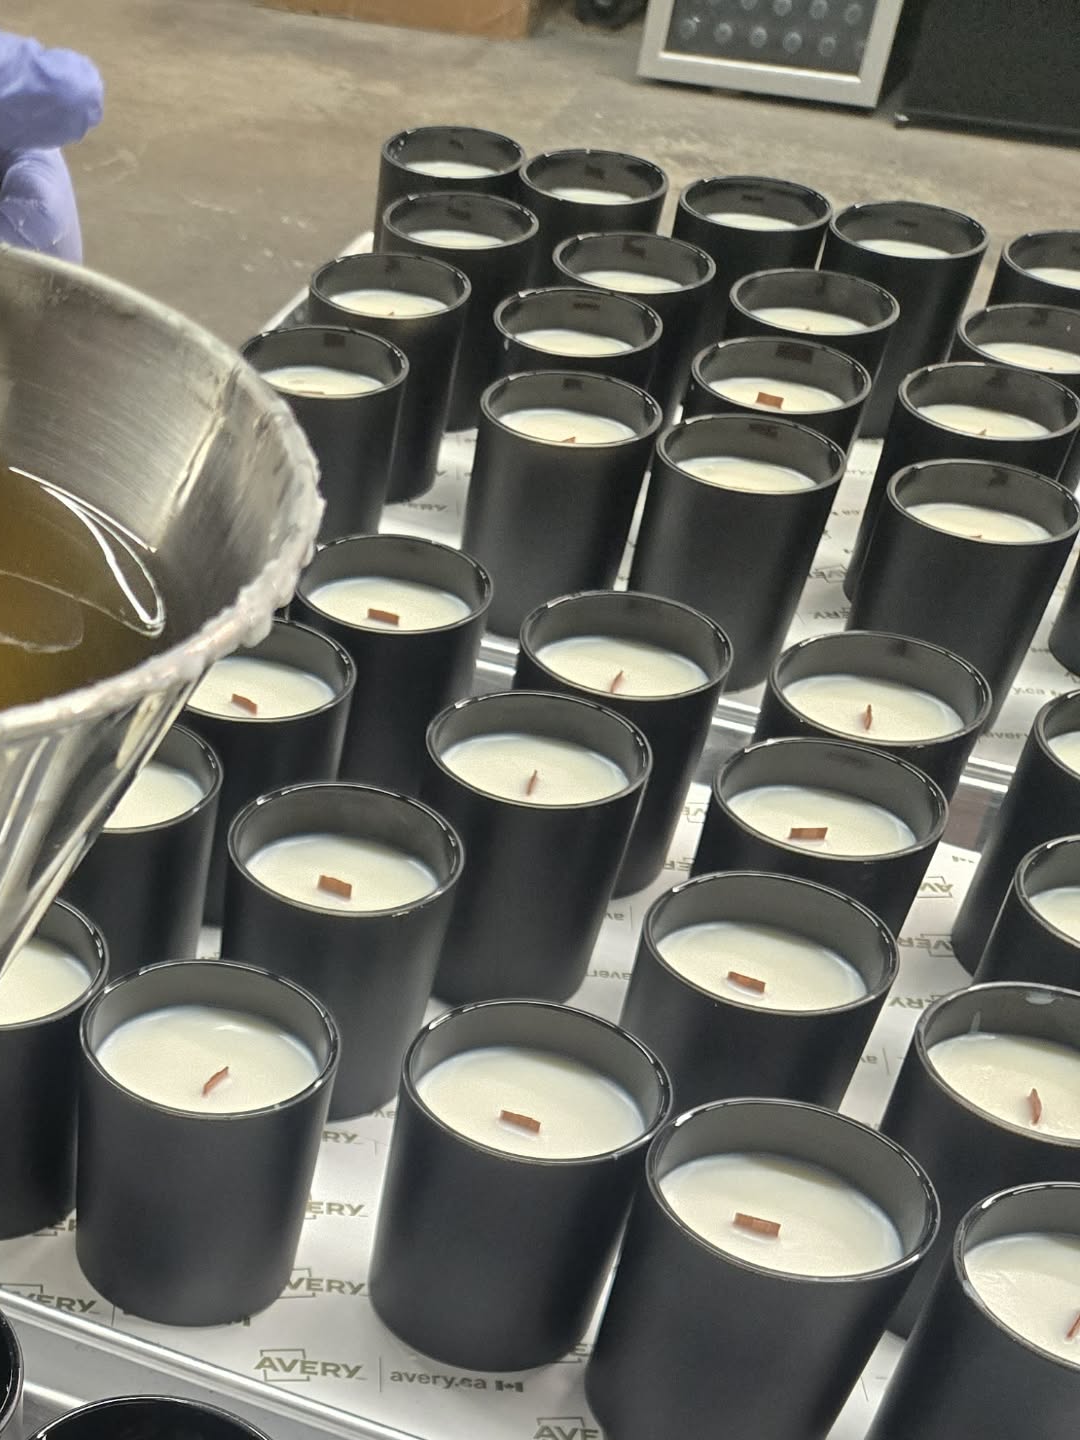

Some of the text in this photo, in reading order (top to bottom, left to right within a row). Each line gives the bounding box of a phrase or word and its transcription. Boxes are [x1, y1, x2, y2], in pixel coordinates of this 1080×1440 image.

[285, 1277, 366, 1295] VERY
[253, 1356, 487, 1390] AVERY avery.ca
